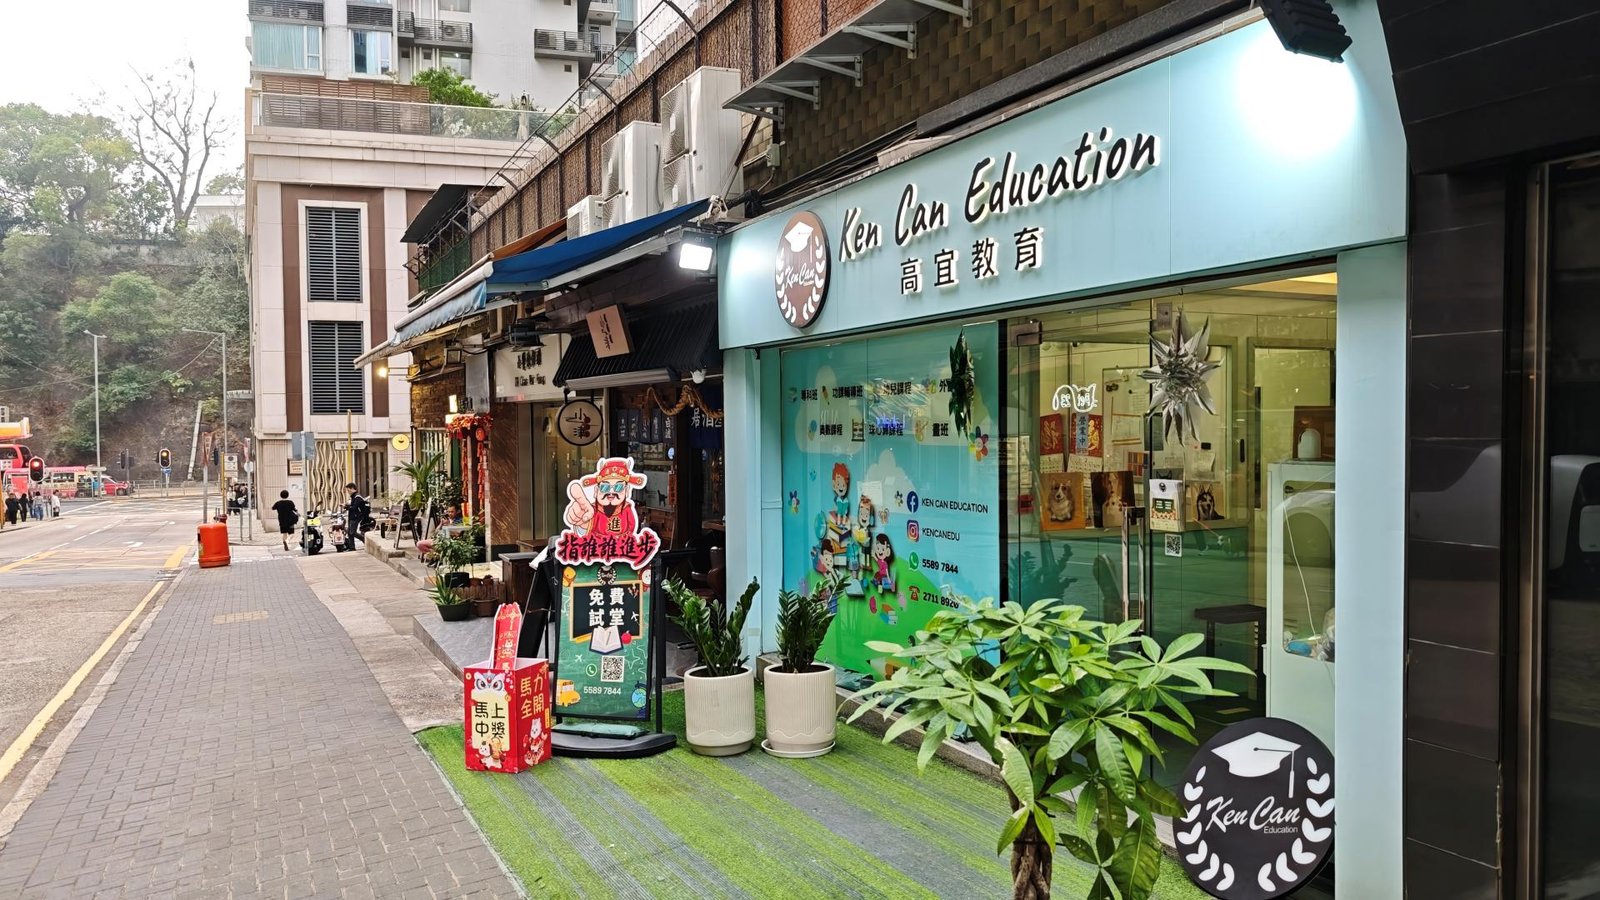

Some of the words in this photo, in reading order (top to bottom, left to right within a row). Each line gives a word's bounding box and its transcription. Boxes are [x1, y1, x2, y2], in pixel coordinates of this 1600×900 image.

[839, 207, 882, 263] Ken
[894, 182, 949, 247] Can
[964, 126, 1161, 225] Education
[899, 226, 1045, 296] 高宜教育
[921, 498, 934, 507] KEN
[935, 499, 948, 509] CAN
[949, 501, 988, 514] EDUCATION
[607, 517, 621, 532] 進
[921, 528, 960, 542] KENCANEDU
[557, 531, 658, 567] 指誰誰進步
[921, 558, 939, 571] 5589
[941, 562, 959, 574] 7844
[588, 587, 625, 606] 免費
[922, 591, 939, 604] 2711
[588, 608, 625, 627] 試堂
[520, 673, 544, 699] 馬力
[583, 685, 602, 695] 5589
[603, 686, 622, 696] 7844
[474, 701, 506, 719] 馬上
[521, 693, 545, 720] 全開
[474, 720, 506, 739] 中獎
[1263, 825, 1298, 834] Education
